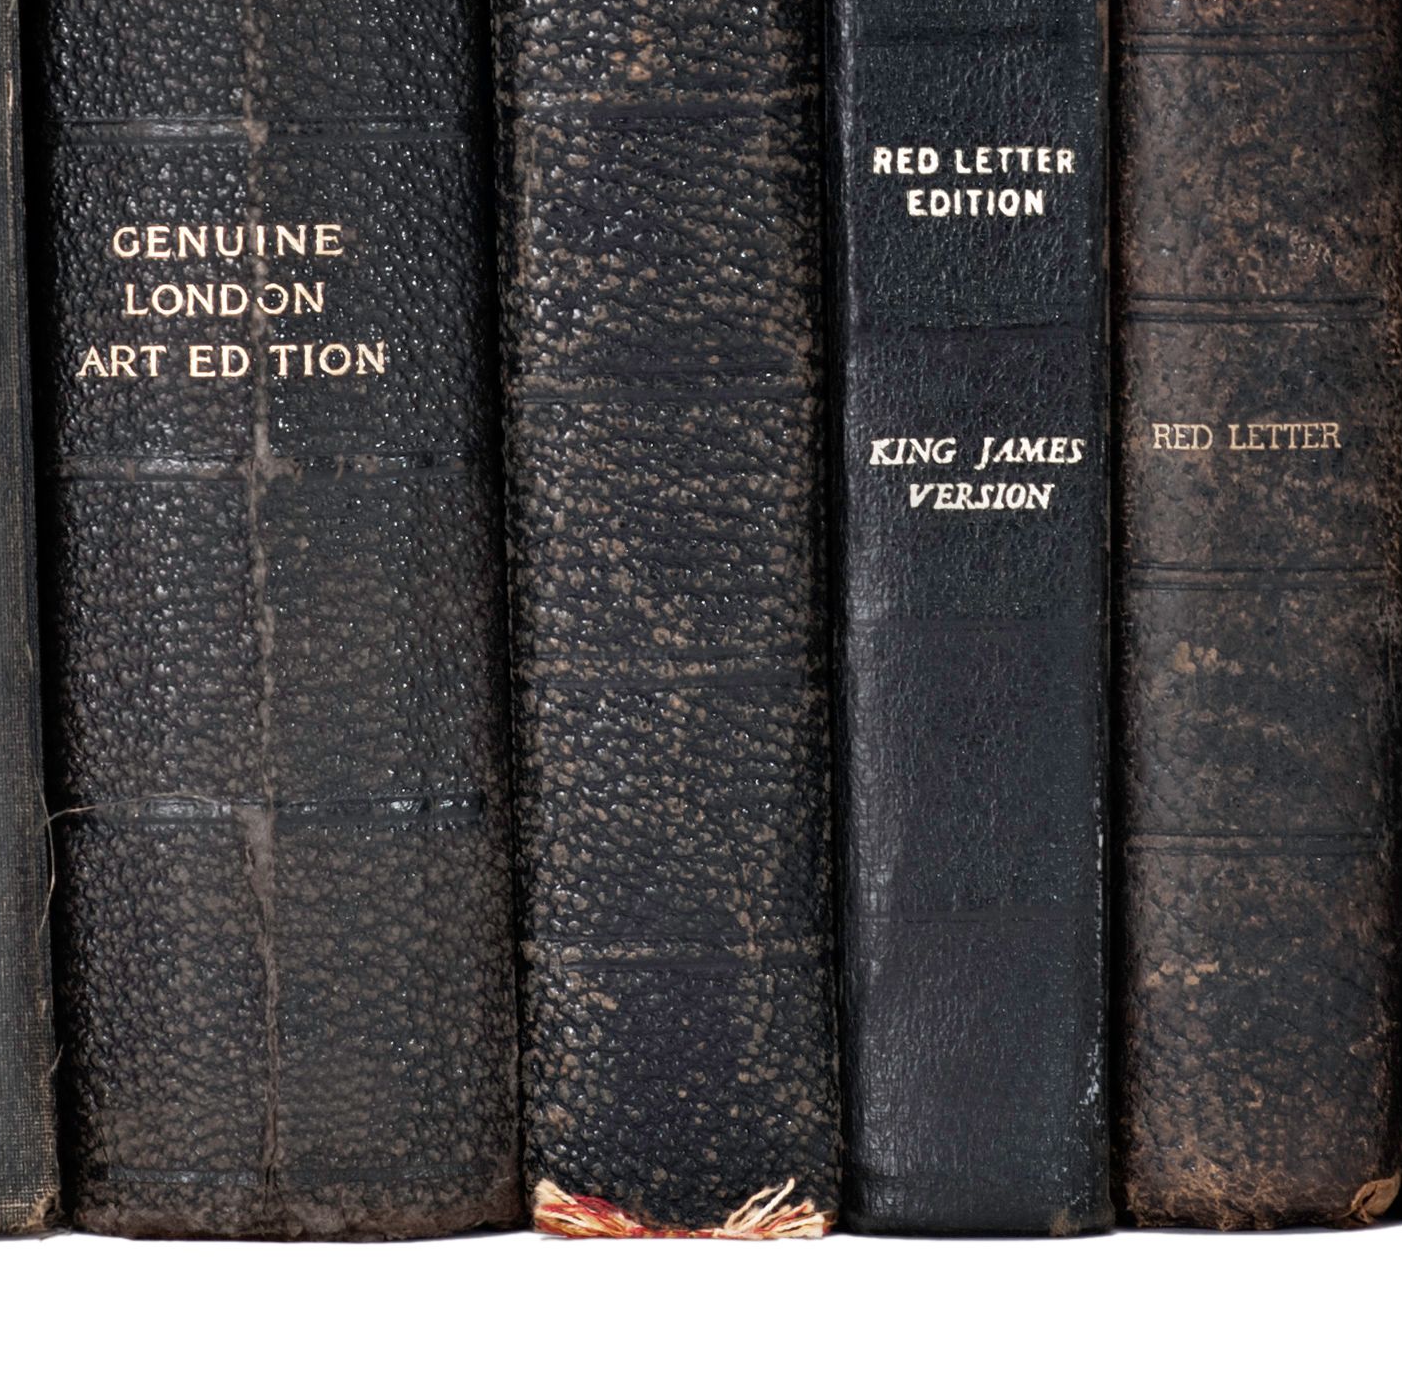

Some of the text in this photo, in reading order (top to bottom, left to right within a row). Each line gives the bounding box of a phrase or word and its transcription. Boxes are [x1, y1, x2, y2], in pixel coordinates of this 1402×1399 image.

[873, 146, 1075, 175] RED LETTER
[906, 188, 1045, 217] EDITION
[112, 223, 344, 259] GENUINE
[125, 281, 325, 317] LONDON
[77, 340, 387, 378] ART EDTION
[1151, 422, 1342, 450] RED LETTER
[869, 437, 1087, 471] KING JAMES
[909, 482, 1055, 510] VERSION
